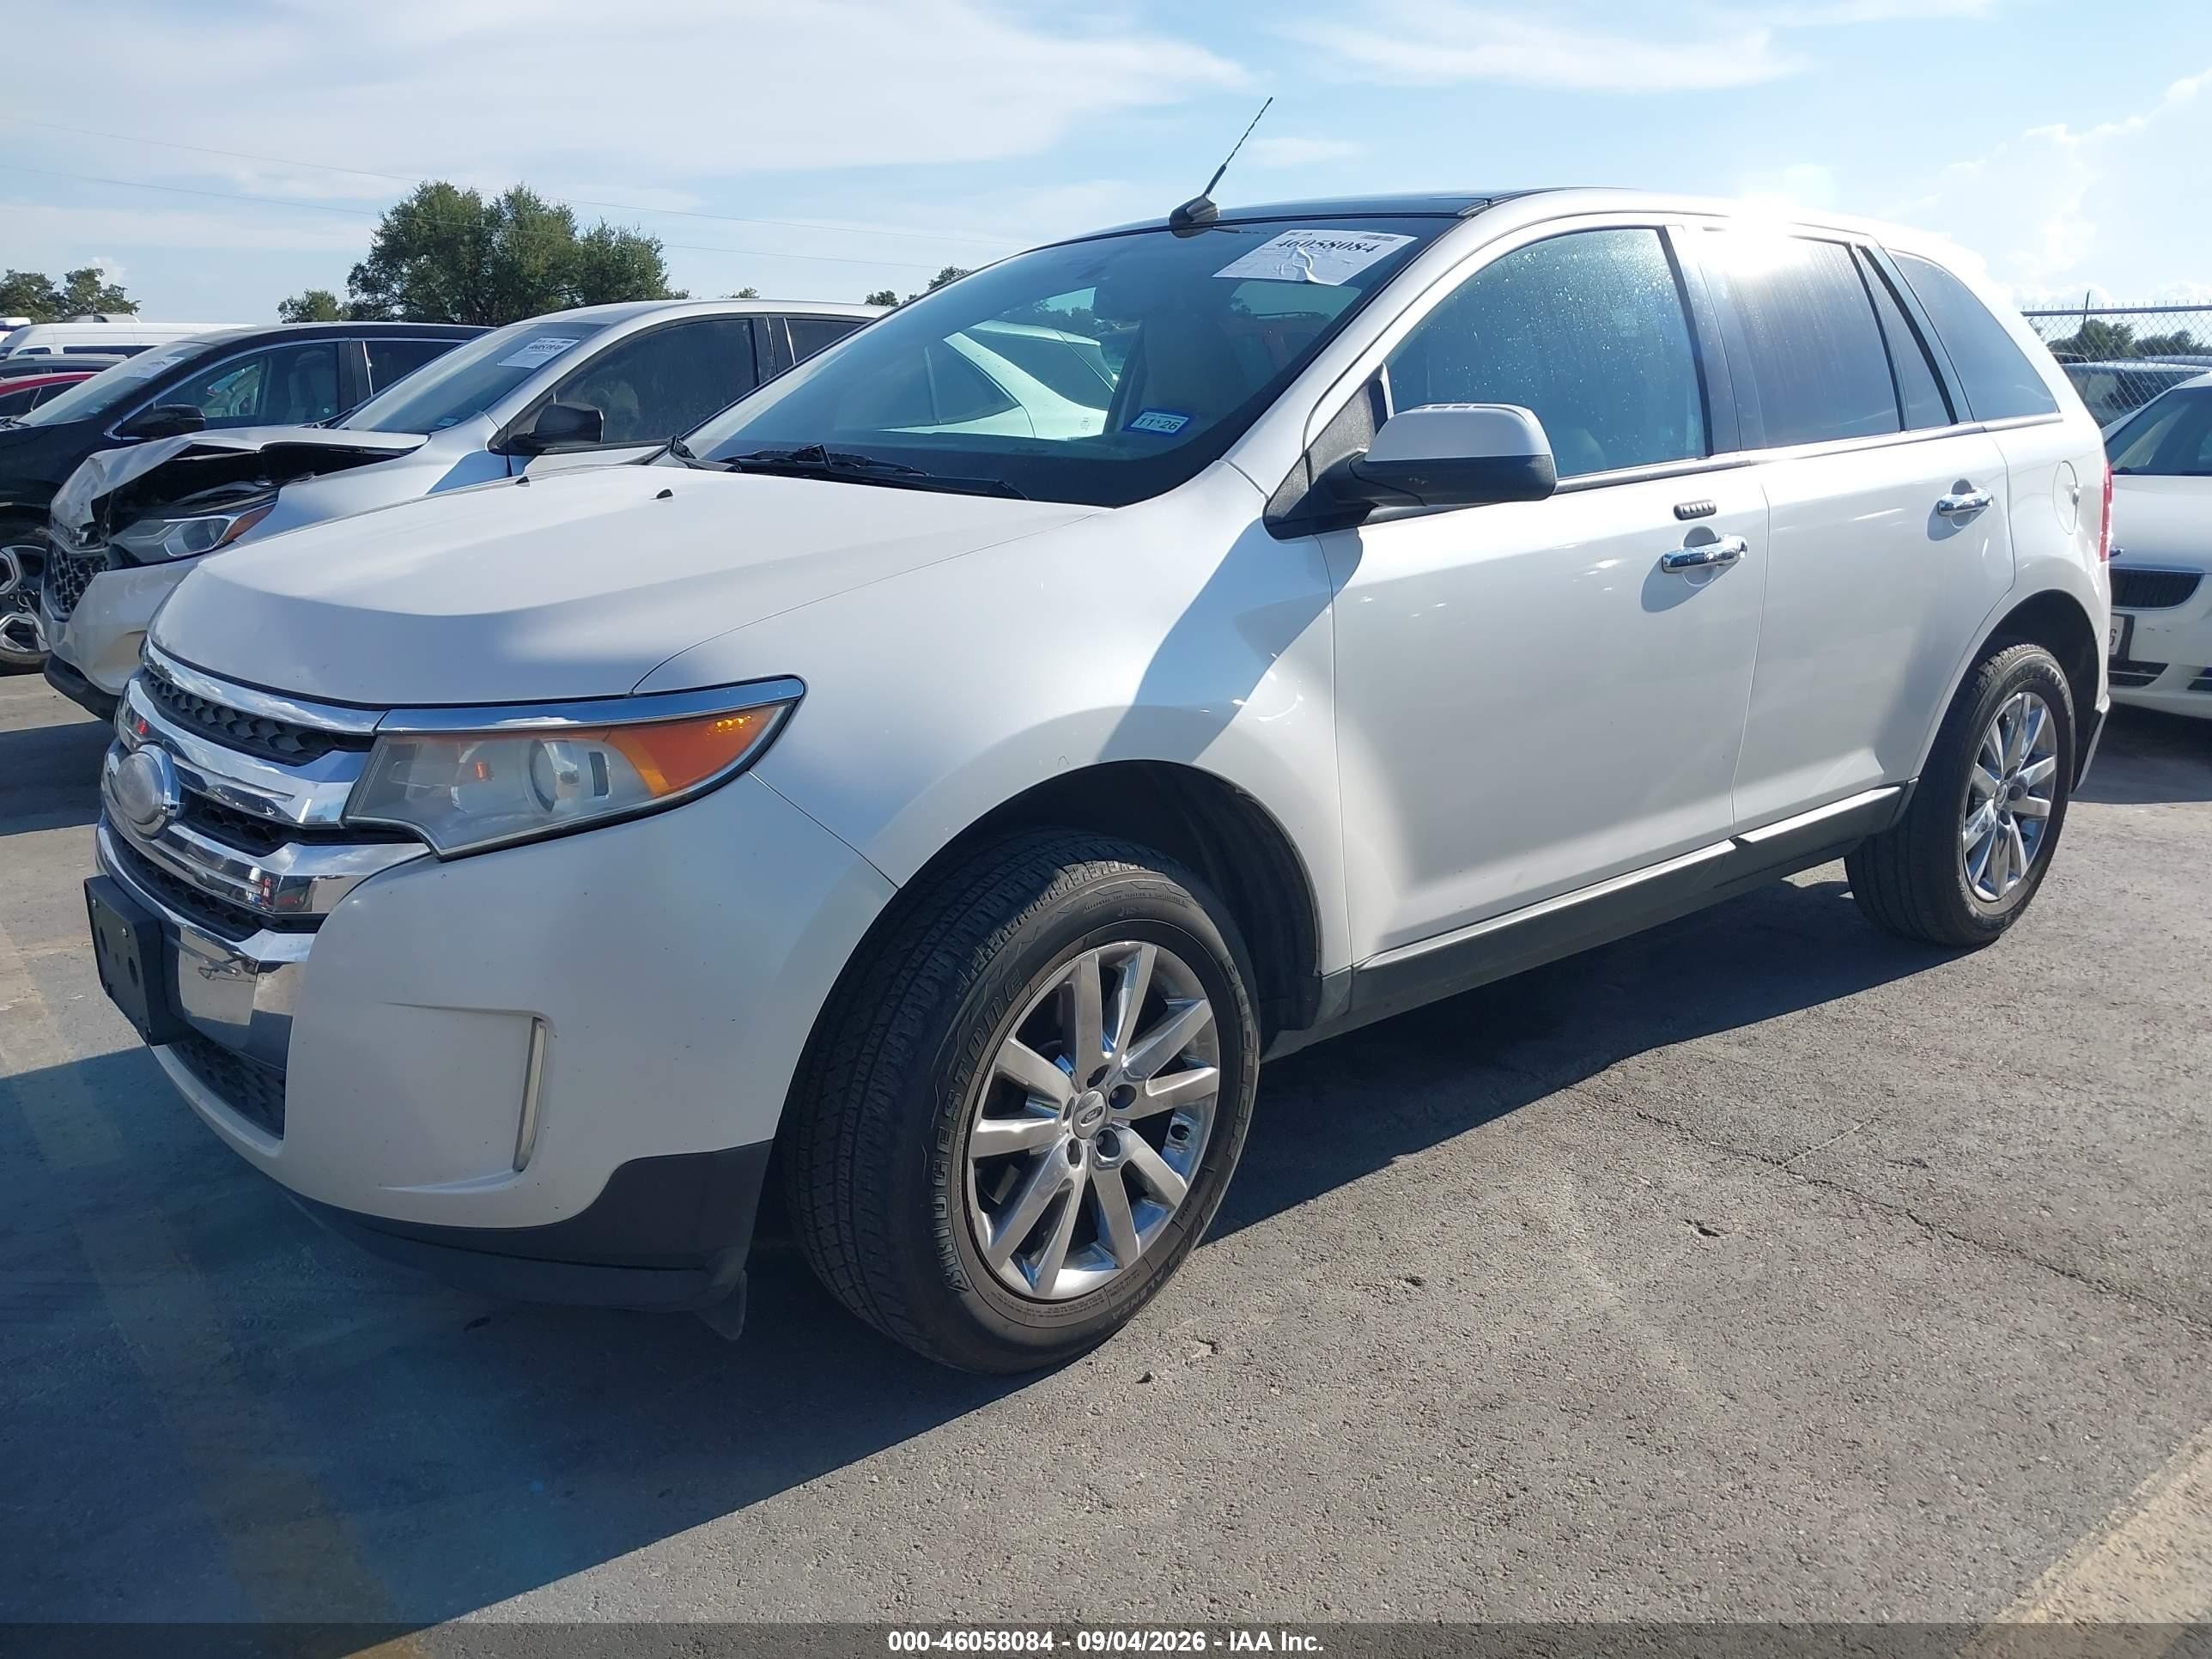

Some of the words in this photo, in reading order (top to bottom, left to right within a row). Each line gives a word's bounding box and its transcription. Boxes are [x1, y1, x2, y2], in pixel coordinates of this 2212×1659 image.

[1275, 238, 1382, 254] 46058084
[1138, 417, 1156, 427] 11
[1158, 420, 1181, 430] 26
[932, 967, 1024, 1293] BRIDGESTONE
